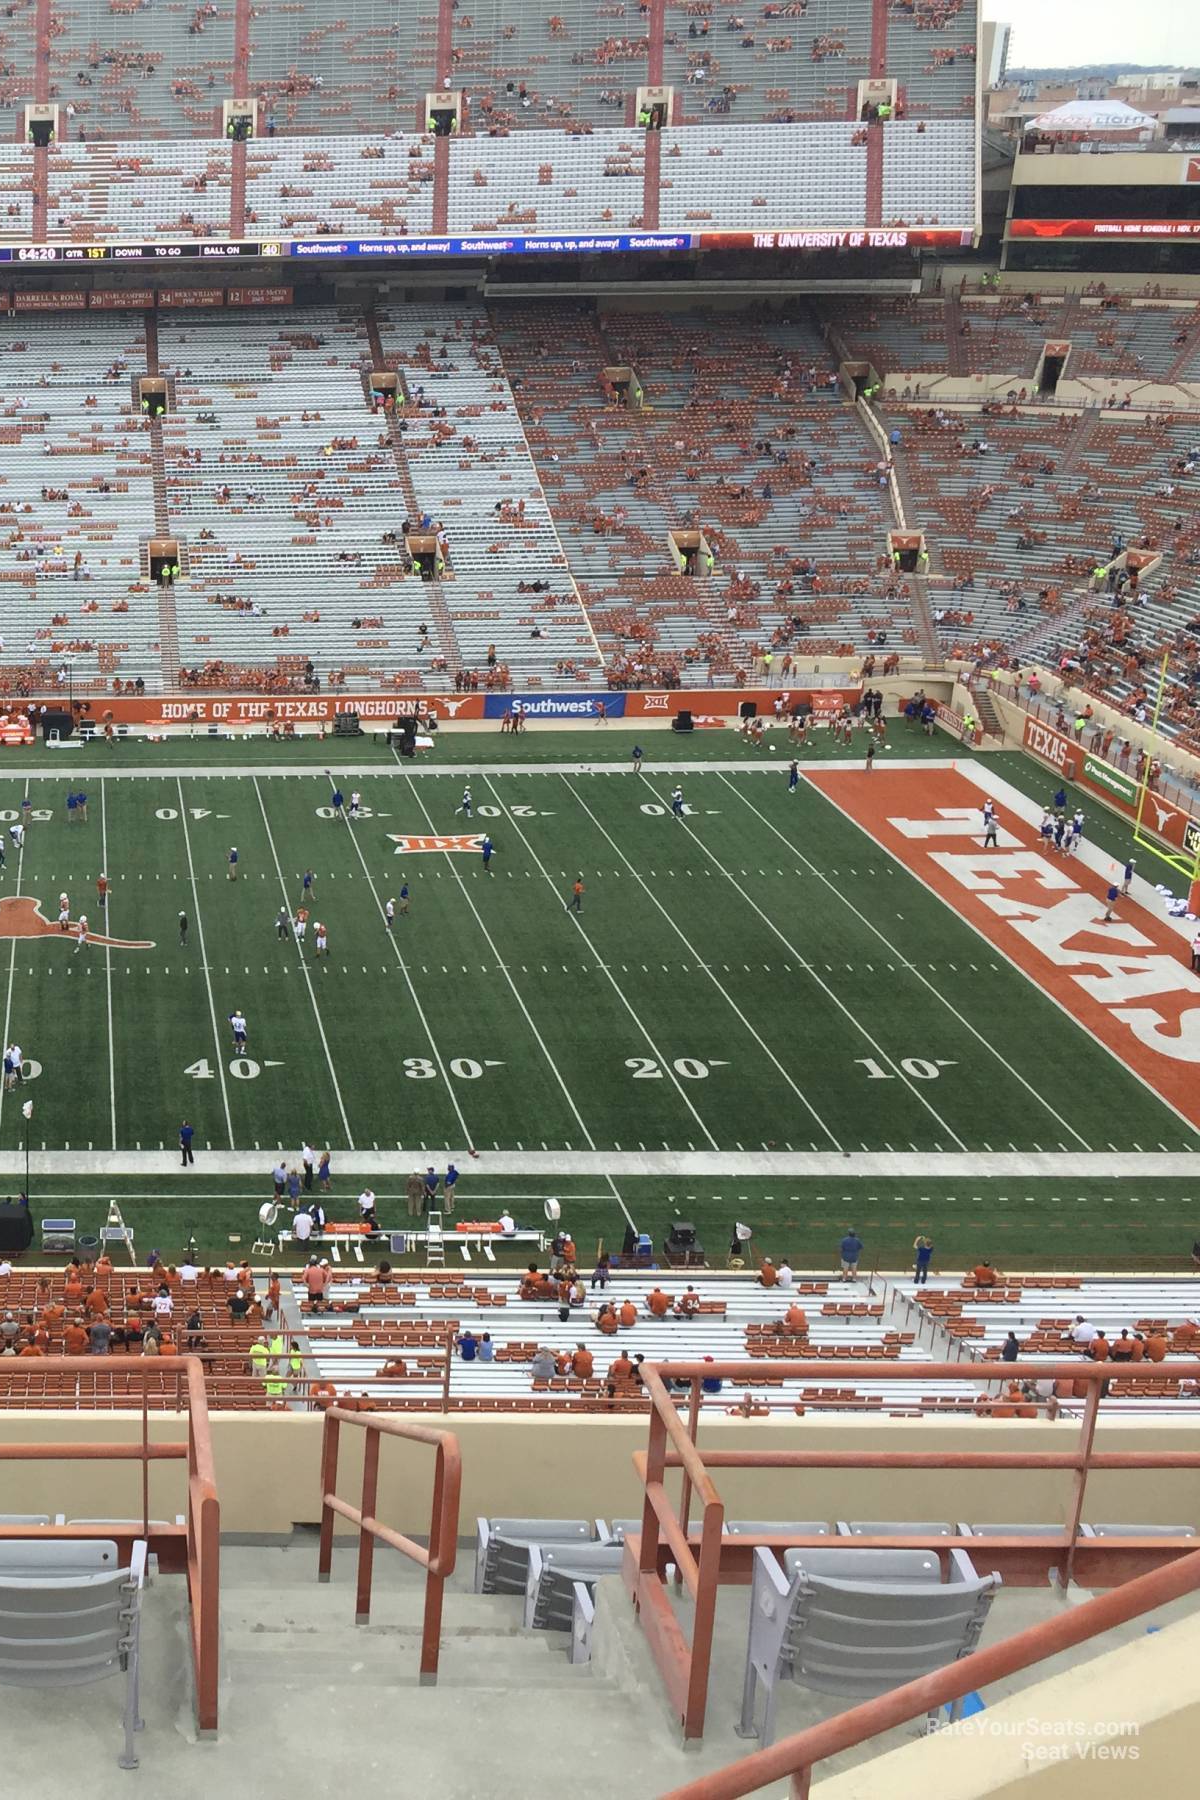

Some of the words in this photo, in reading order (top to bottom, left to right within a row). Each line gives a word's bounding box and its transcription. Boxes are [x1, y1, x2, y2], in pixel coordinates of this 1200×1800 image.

[461, 241, 506, 250] Southwest
[525, 241, 549, 249] Horns
[550, 241, 563, 251] up,
[565, 241, 577, 250] up,
[579, 239, 594, 248] and
[595, 239, 619, 250] away!
[630, 238, 677, 247] Southwest
[753, 234, 774, 248] THE
[778, 233, 845, 247] UNIVERSITY
[849, 233, 865, 246] OF
[869, 232, 908, 246] TEXAS
[66, 250, 82, 258] QTR
[87, 248, 105, 258] 1ST
[115, 248, 142, 257] DOWN
[155, 248, 166, 256] TO
[168, 248, 181, 256] GO
[204, 246, 225, 255] BALL
[226, 246, 240, 254] ON
[297, 245, 341, 254] Southwest
[359, 244, 382, 252] Horns
[384, 245, 396, 254] up,
[398, 244, 410, 254] up,
[411, 243, 426, 251] and
[427, 242, 450, 252] away!
[18, 249, 56, 260] 64:20
[16, 294, 48, 302] DARRELL
[91, 296, 102, 305] 20
[160, 294, 171, 303] 34
[230, 292, 240, 302] 12
[162, 703, 206, 718] HOME
[212, 703, 231, 718] OF
[275, 702, 327, 717] TEXAS
[335, 701, 427, 716] LONGHORNS
[512, 699, 592, 713] Southwest
[1027, 721, 1068, 766] TEXAS
[155, 808, 212, 820] 40
[477, 804, 537, 817] 20
[886, 807, 1200, 1064] TEXAS
[184, 1059, 261, 1079] 40
[402, 1058, 484, 1079] 30
[625, 1058, 713, 1079] 20
[853, 1058, 941, 1079] 10
